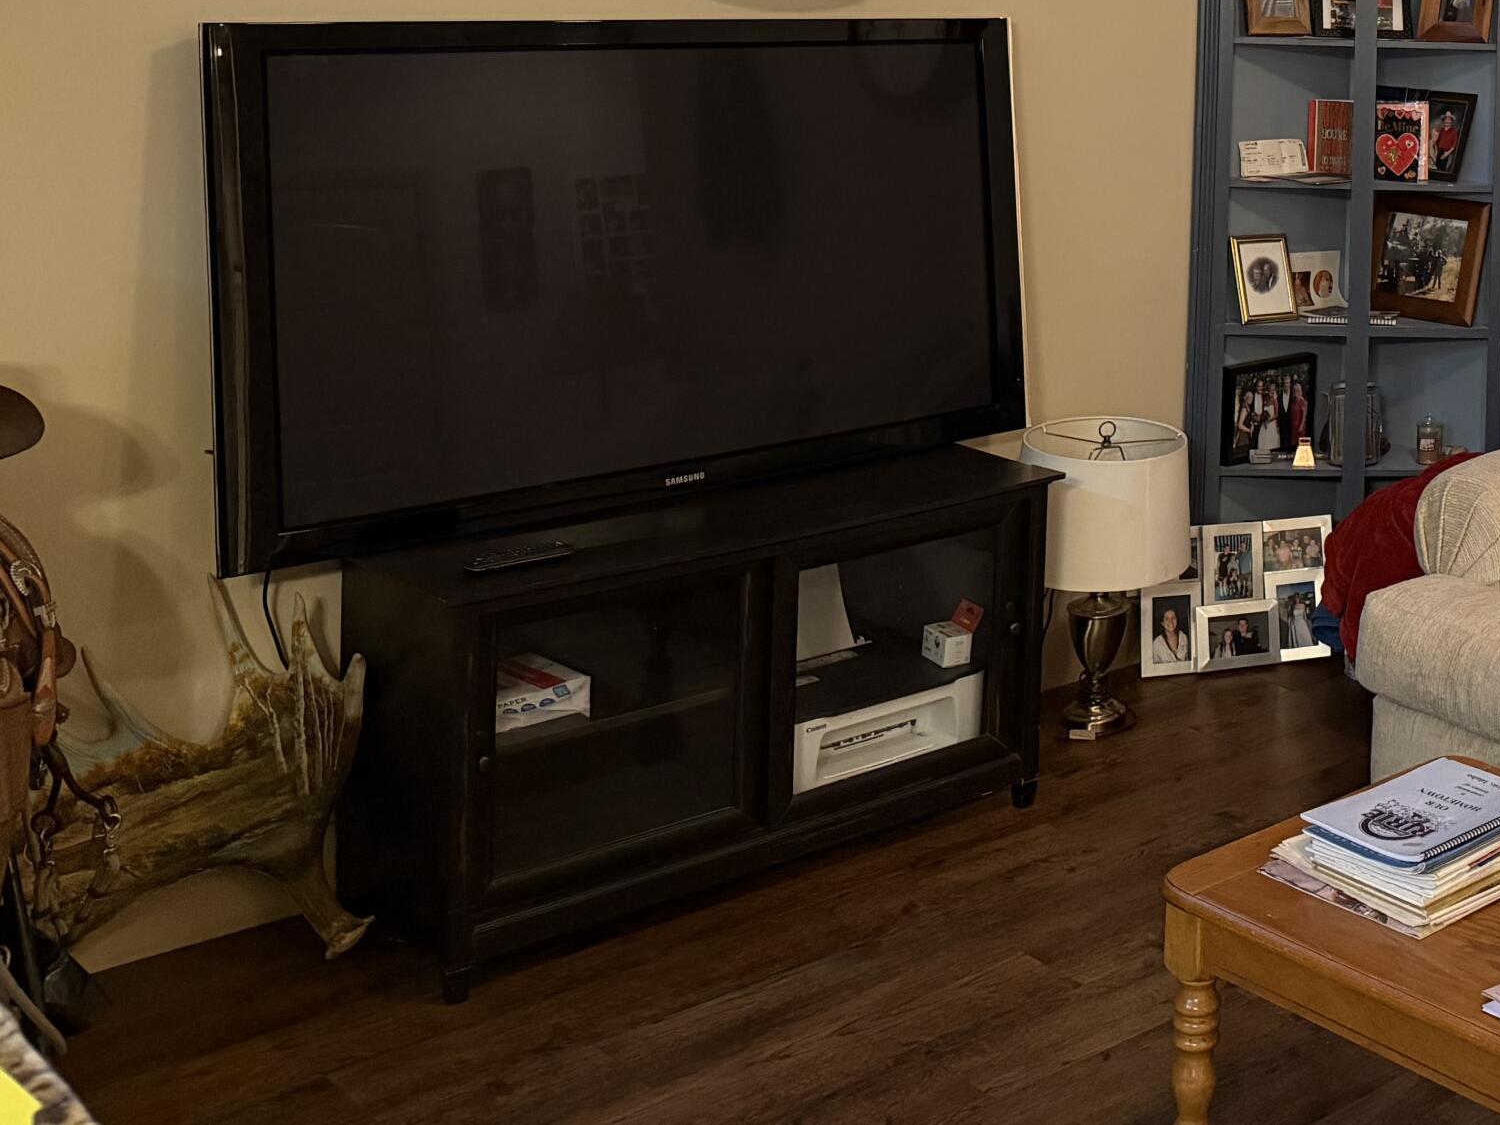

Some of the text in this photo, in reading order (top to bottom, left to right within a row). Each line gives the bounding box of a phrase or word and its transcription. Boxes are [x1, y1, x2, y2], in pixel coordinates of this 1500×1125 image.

[665, 471, 705, 486] SAMSUNG
[497, 697, 527, 709] PAPER
[1418, 787, 1483, 812] HOMETOWN
[1425, 799, 1450, 811] OUR
